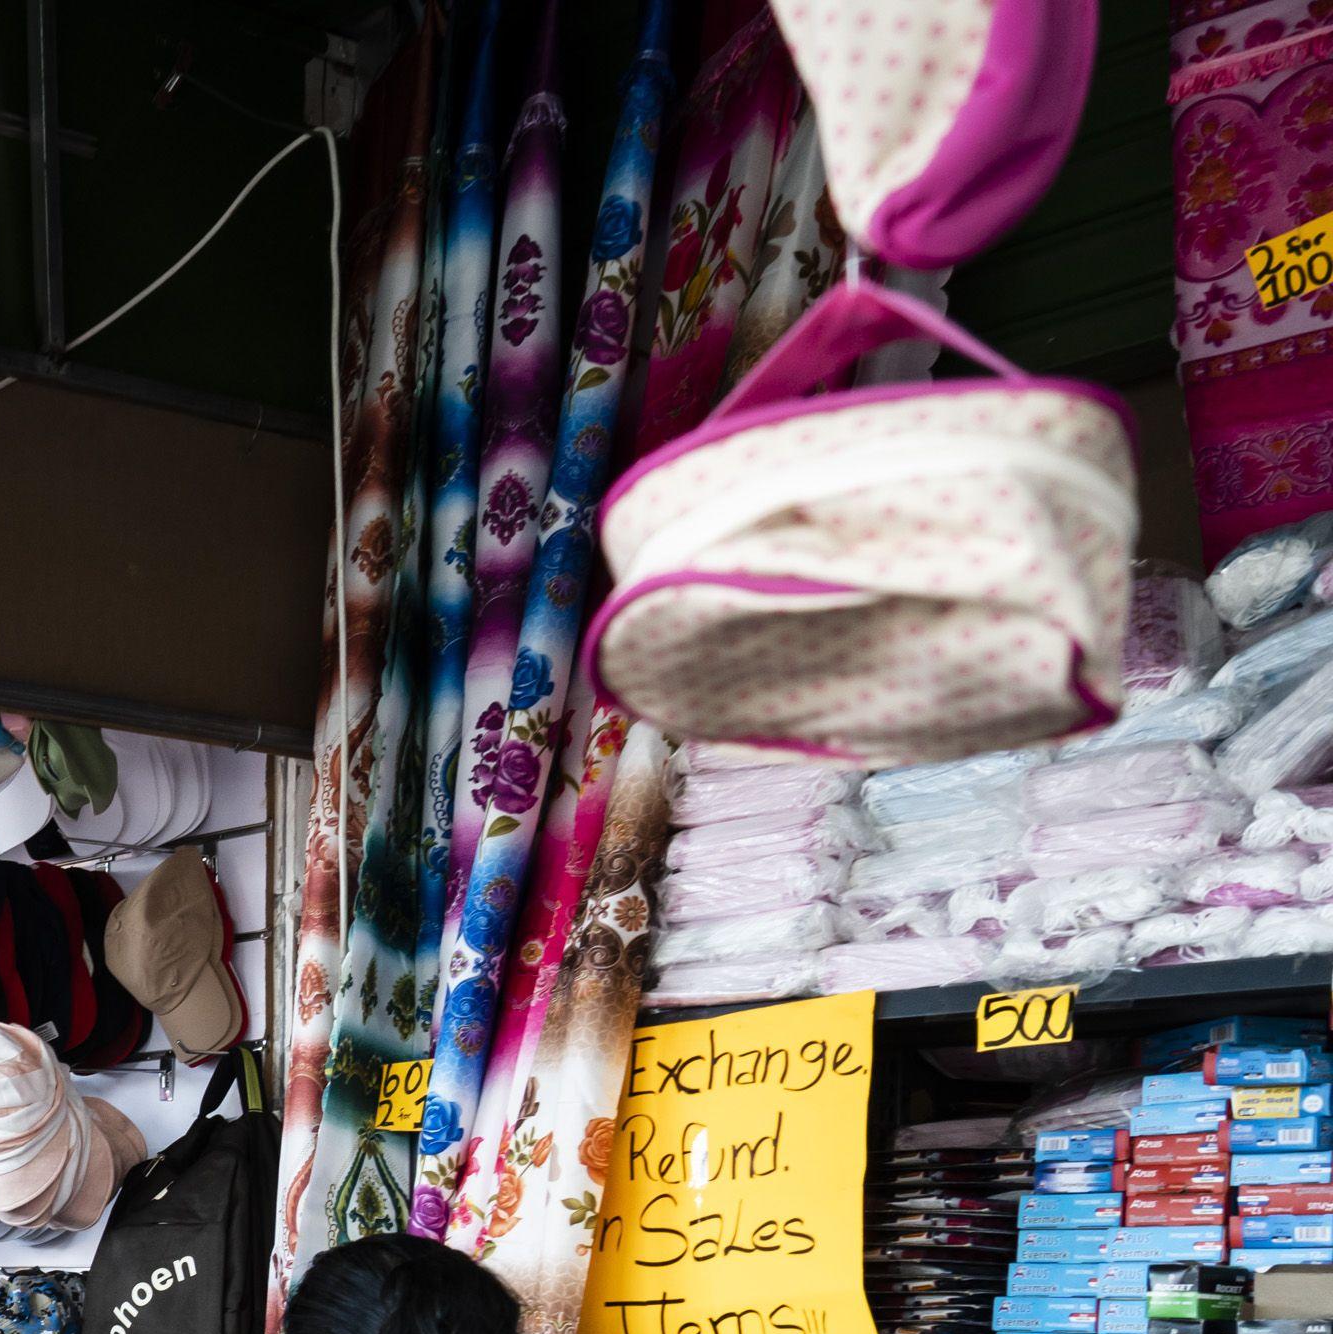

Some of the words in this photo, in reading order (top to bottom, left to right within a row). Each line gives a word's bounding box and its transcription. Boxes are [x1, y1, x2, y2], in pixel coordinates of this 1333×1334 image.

[1250, 245, 1285, 281] 2
[1287, 232, 1326, 256] for
[984, 991, 1076, 1047] 500
[383, 1062, 433, 1098] 60
[379, 1100, 394, 1127] 2
[1022, 1215, 1066, 1225] Evermark
[1023, 1250, 1069, 1260] Evermark
[1111, 1249, 1161, 1258] Evermark
[1011, 1284, 1058, 1293] Evermark
[1102, 1285, 1146, 1294] Evermar
[1153, 1283, 1194, 1292] ROCKET
[996, 1318, 1040, 1327] Evermark
[1102, 1321, 1147, 1331] Evermar
[1306, 1325, 1326, 1333] AAA
